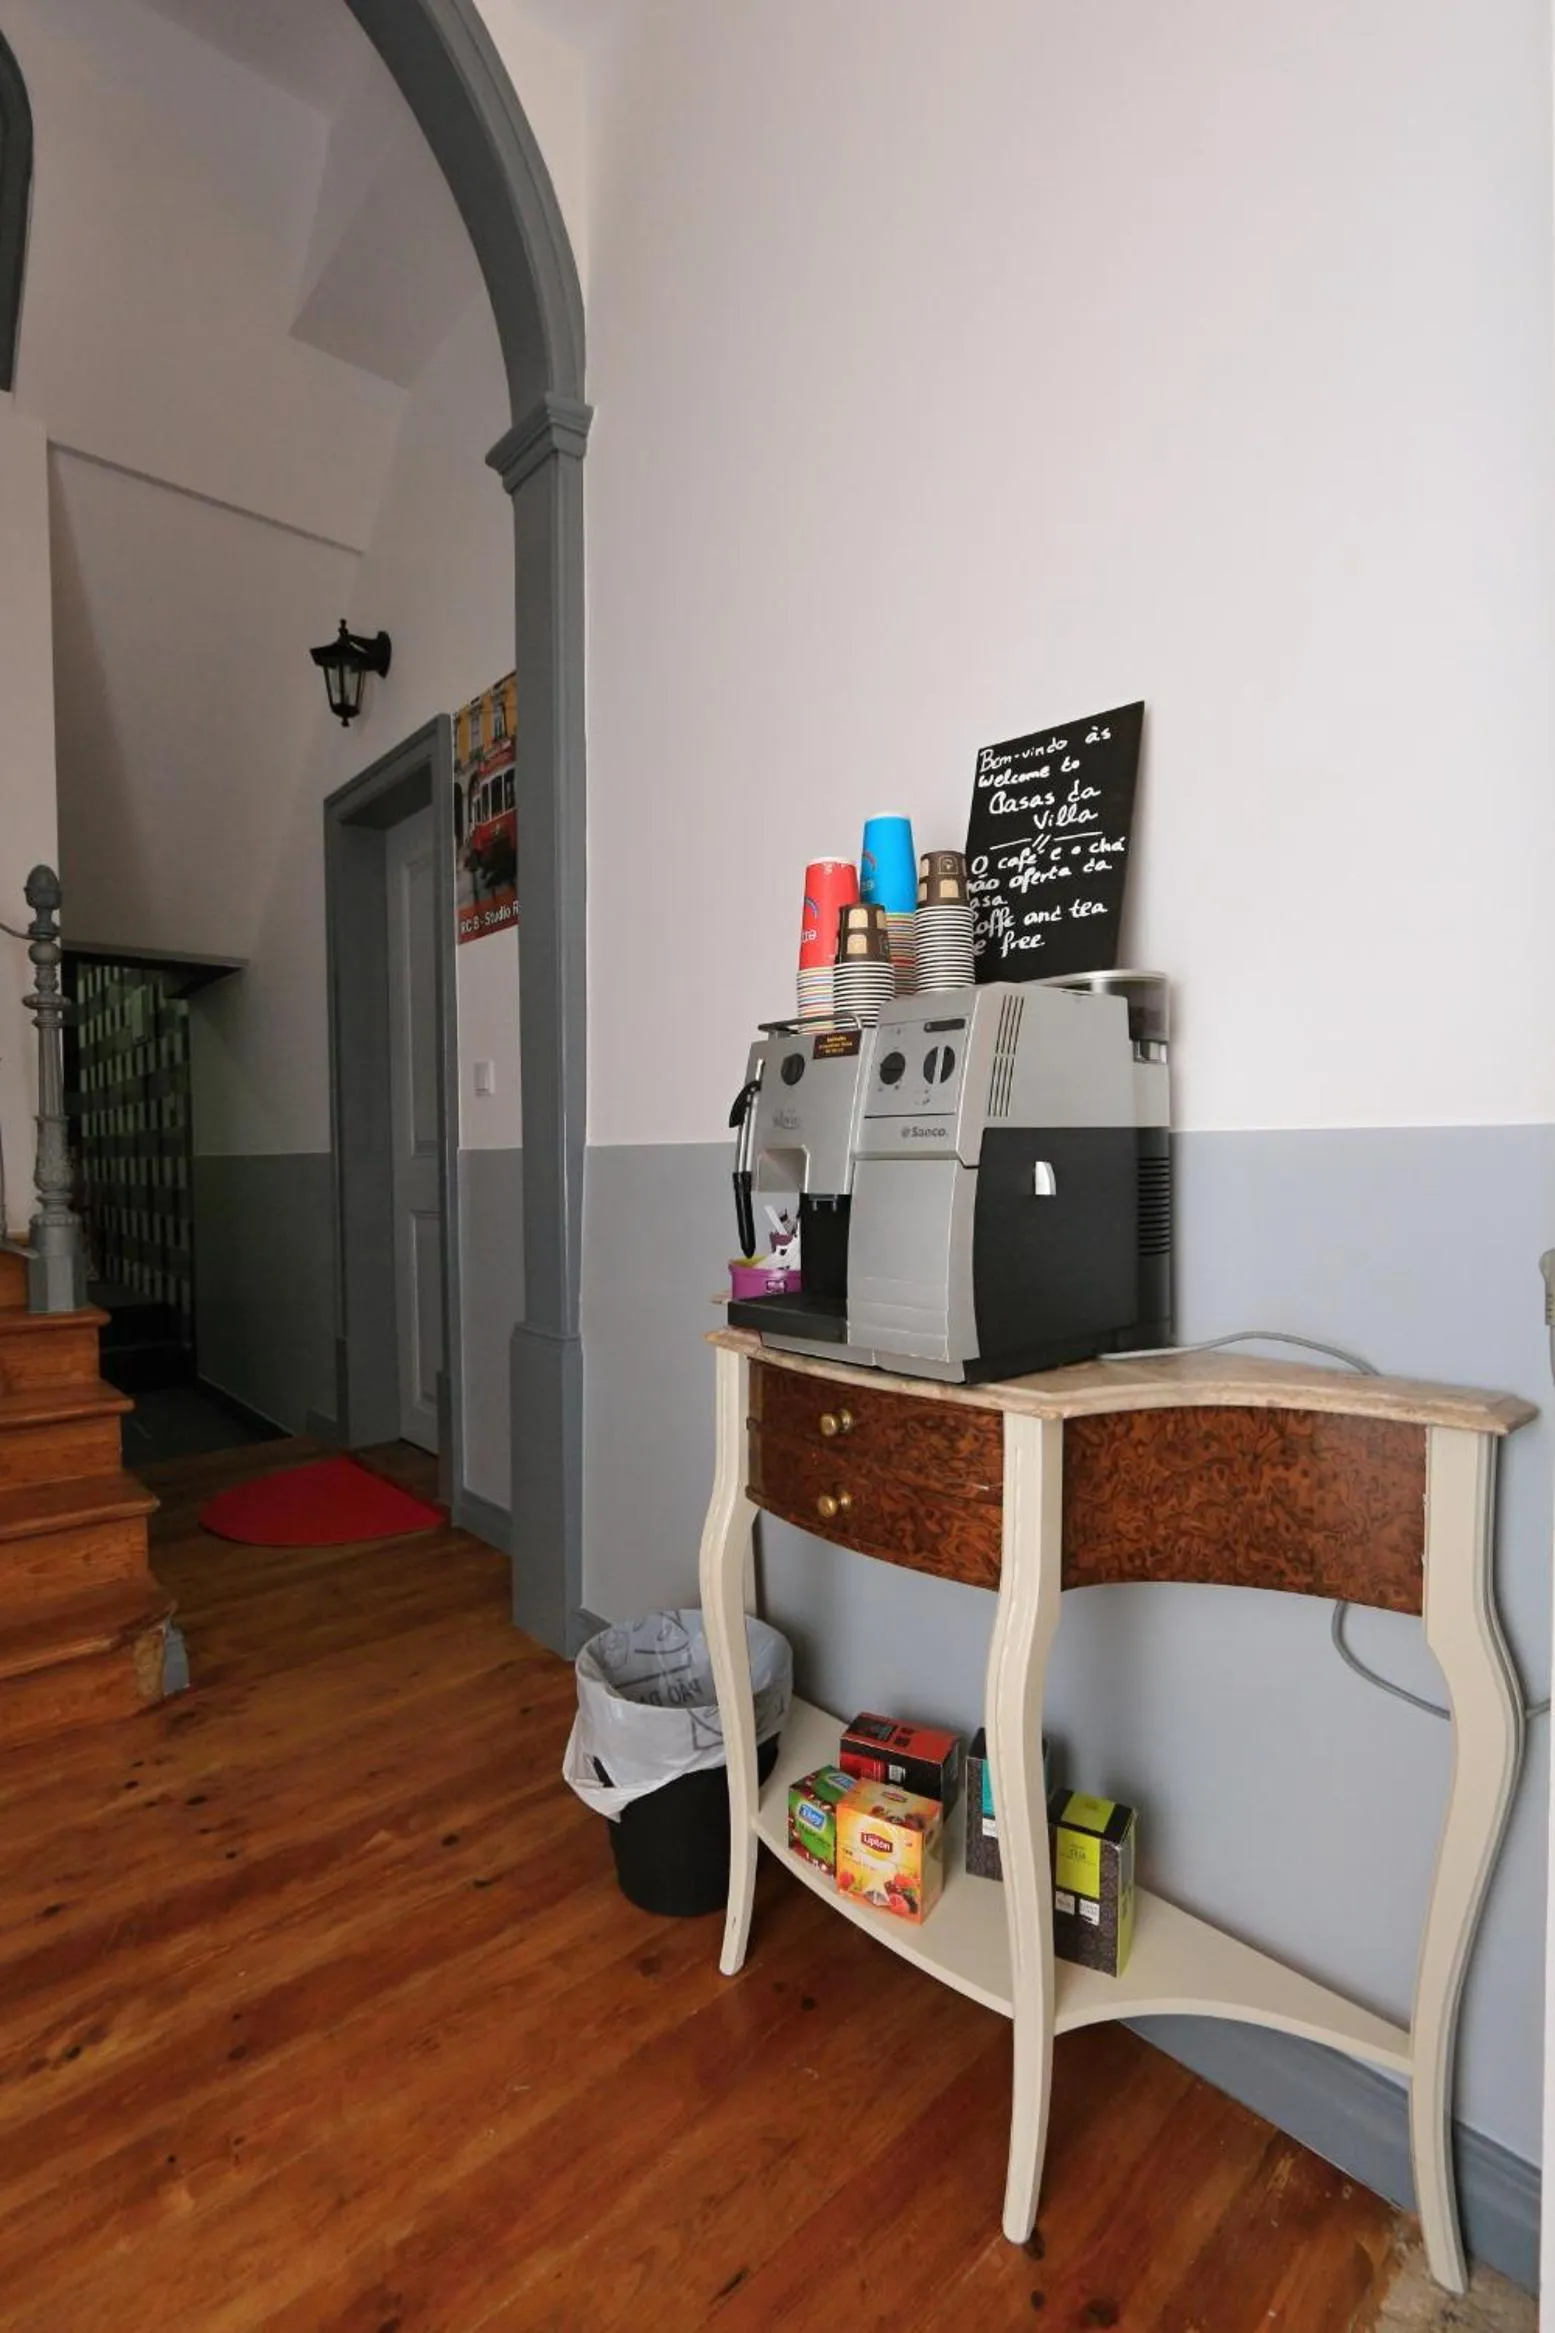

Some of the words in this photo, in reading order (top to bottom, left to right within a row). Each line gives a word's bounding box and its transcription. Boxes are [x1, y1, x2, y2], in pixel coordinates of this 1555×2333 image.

[1084, 725, 1111, 744] às
[977, 764, 1050, 788] welcome
[1060, 755, 1080, 772] to
[988, 790, 1055, 815] Casas
[1067, 778, 1101, 803] da
[1033, 803, 1099, 830] Villa
[997, 846, 1045, 873] café
[1088, 836, 1126, 853] chá
[967, 872, 1000, 893] ão
[1008, 865, 1072, 893] oferta
[1082, 857, 1113, 873] da
[969, 895, 1008, 910] asa
[1023, 904, 1063, 927] and
[1068, 898, 1109, 918] tea
[1000, 930, 1046, 959] free
[862, 1833, 892, 1852] Lipton
